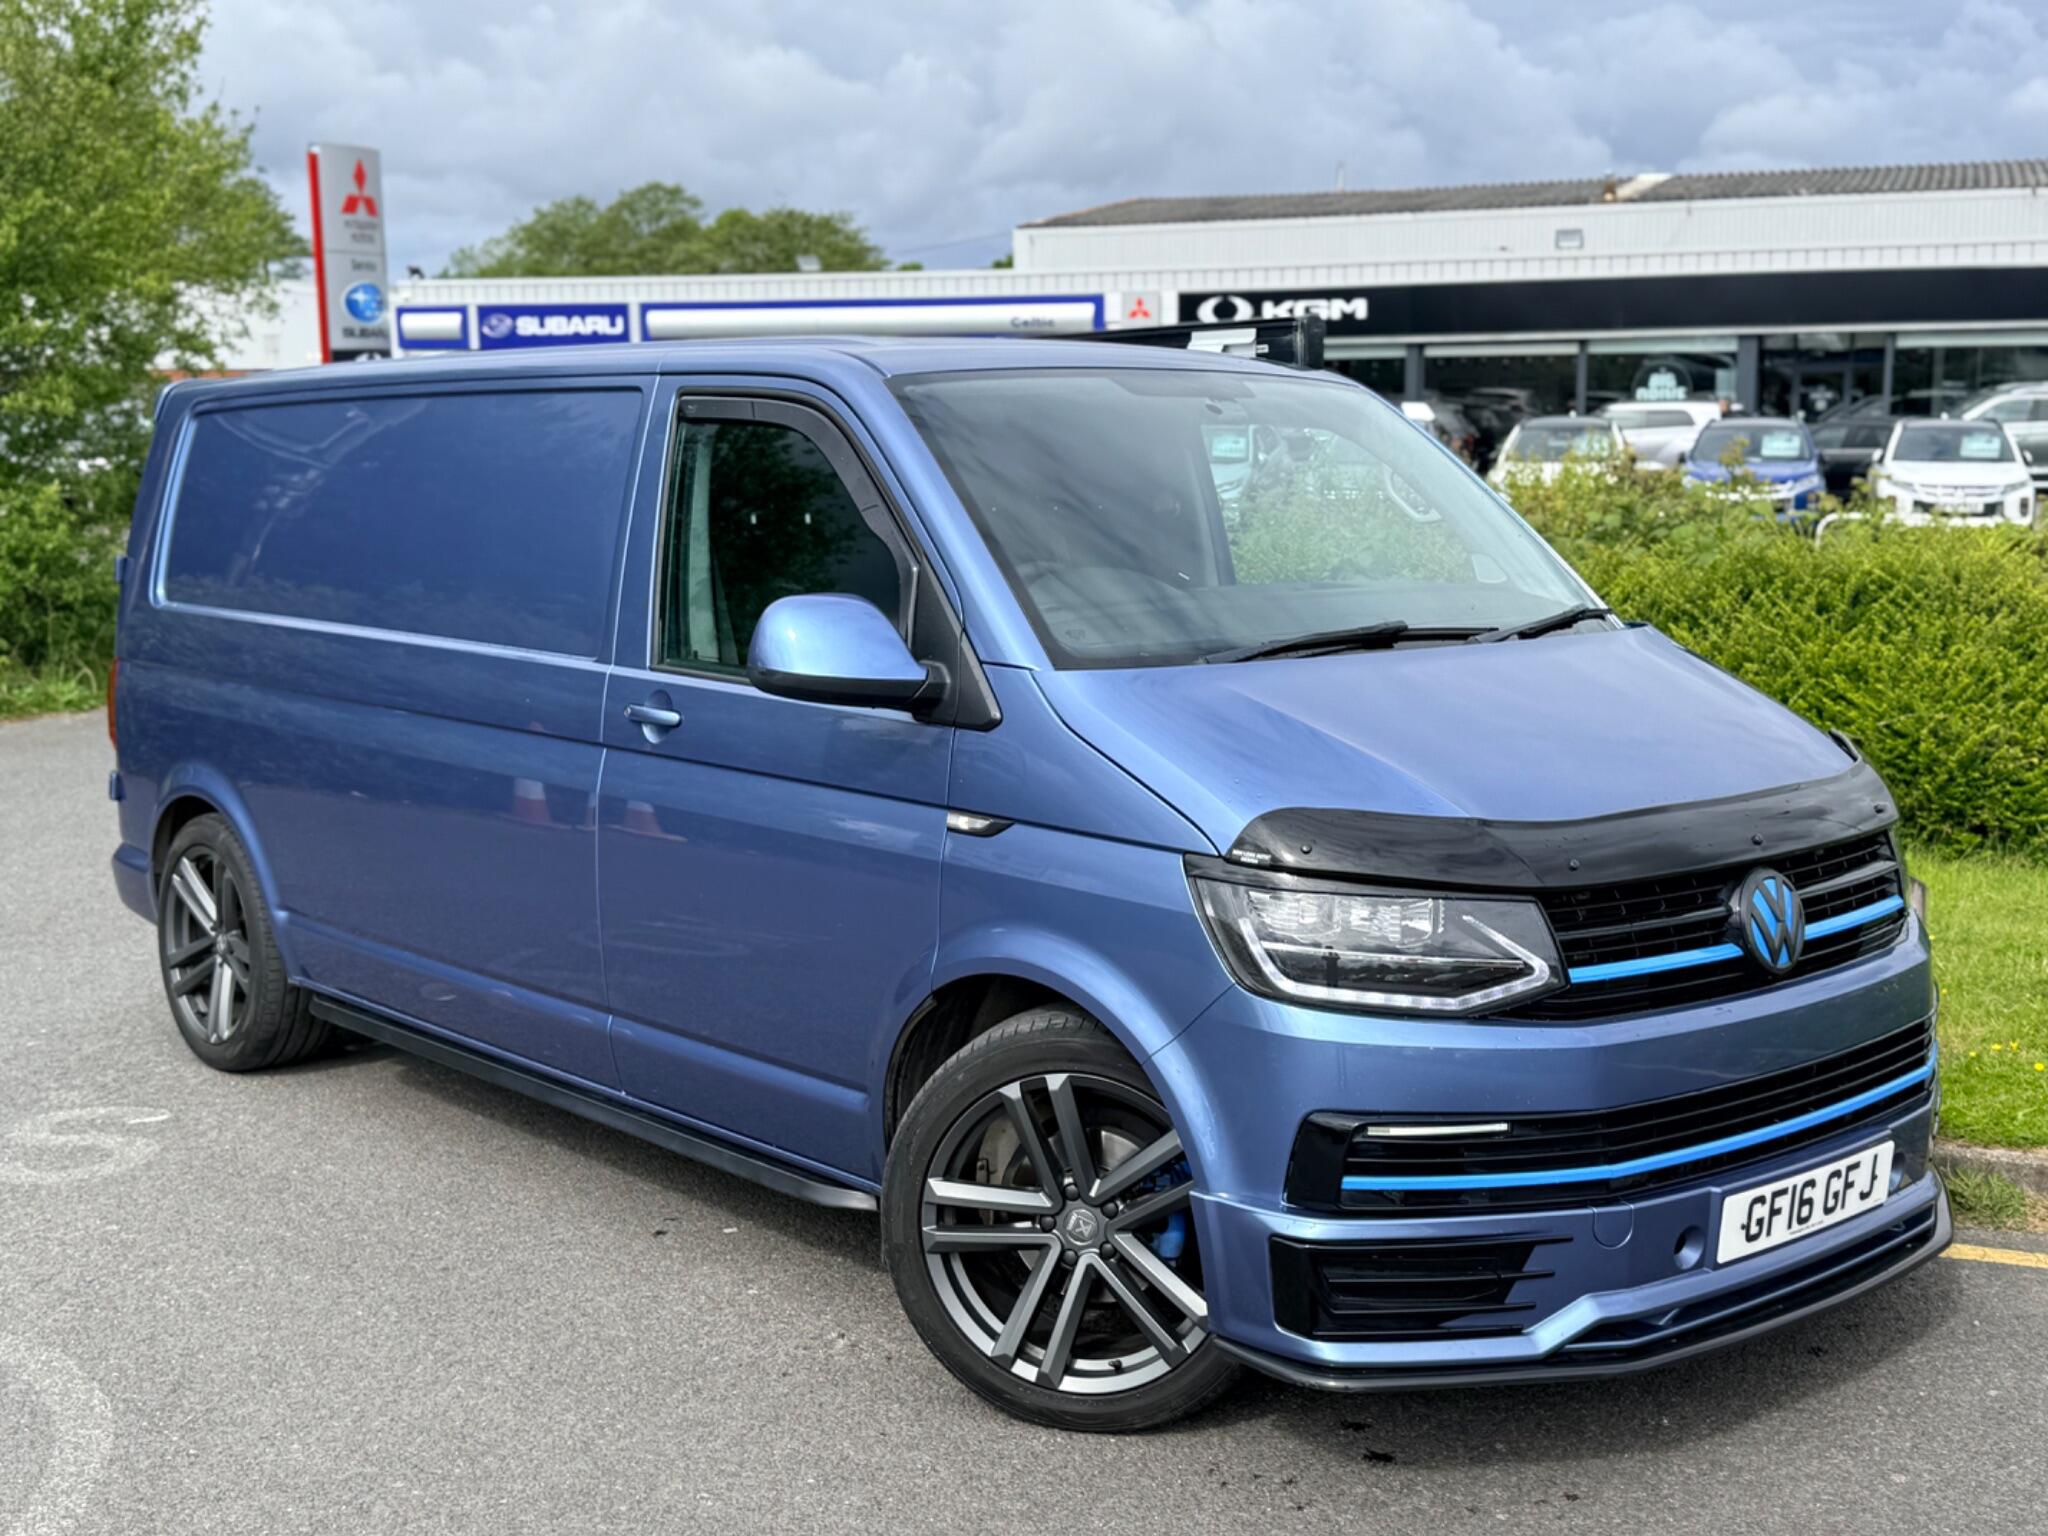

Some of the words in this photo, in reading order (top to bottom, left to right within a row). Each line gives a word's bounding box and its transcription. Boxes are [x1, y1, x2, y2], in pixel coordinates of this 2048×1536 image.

[1261, 297, 1369, 321] KGM
[515, 315, 625, 336] SUBARU
[1744, 1178, 1817, 1243] GF16
[1822, 1153, 1878, 1216] GFJ
